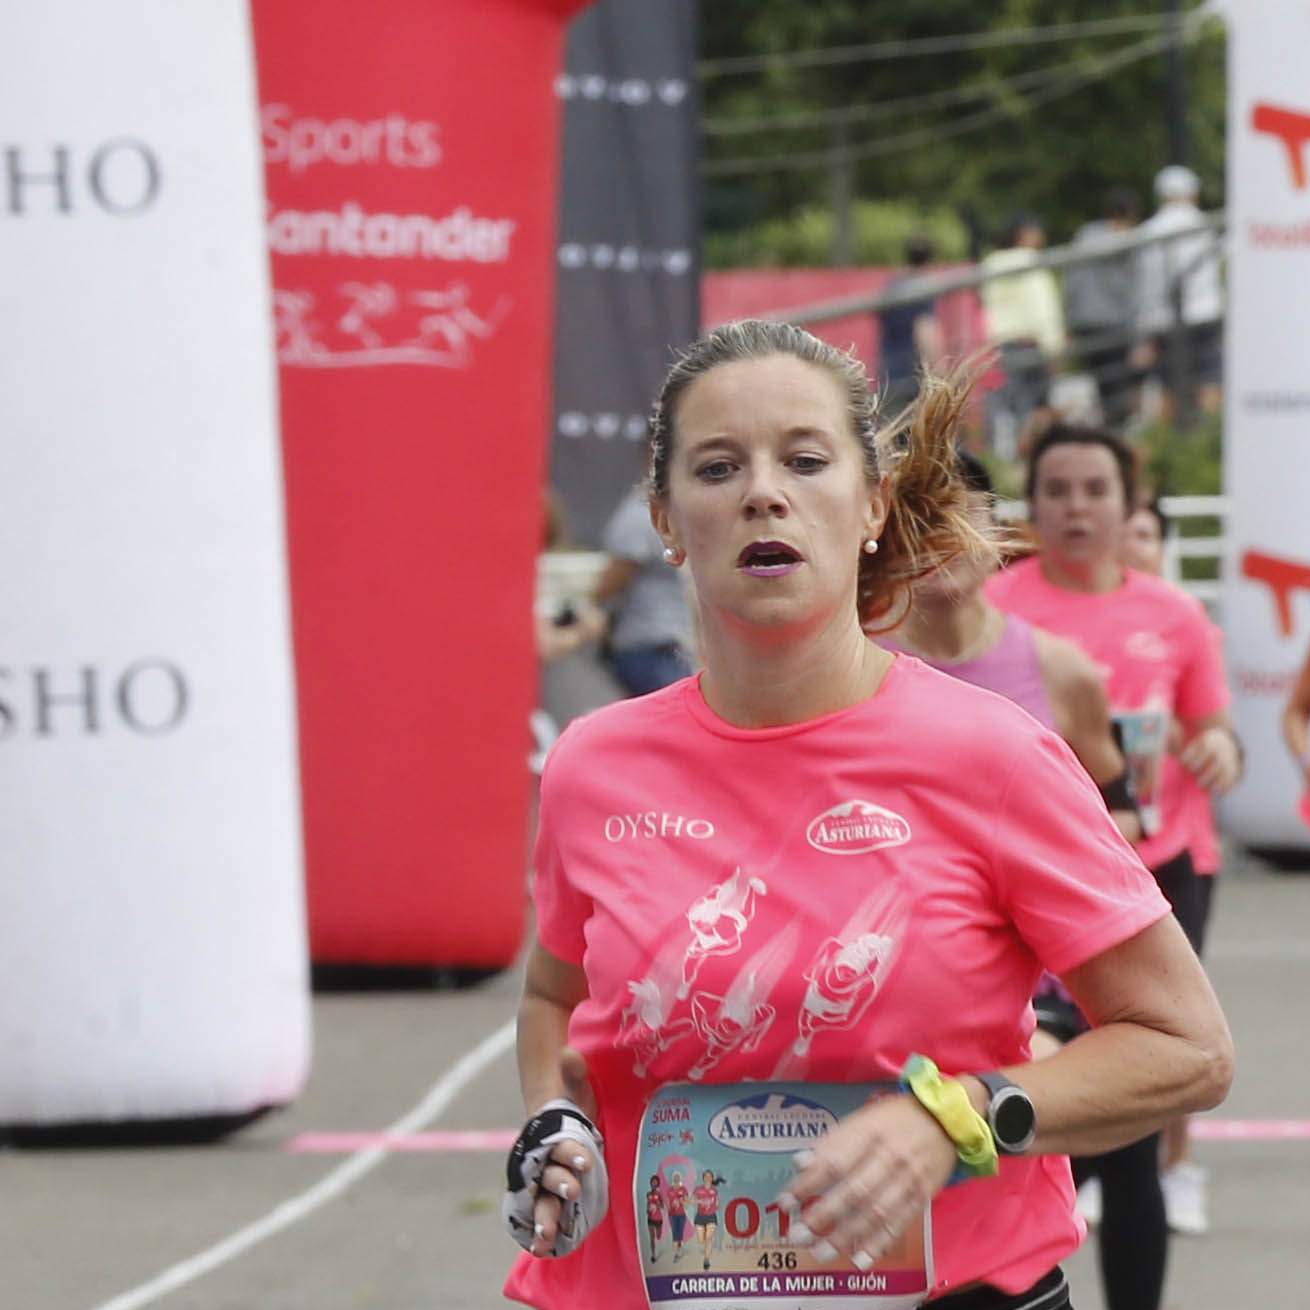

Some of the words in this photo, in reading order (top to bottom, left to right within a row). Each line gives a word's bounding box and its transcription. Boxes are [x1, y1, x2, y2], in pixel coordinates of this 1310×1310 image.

[262, 104, 442, 170] Sports
[266, 202, 516, 263] antander
[604, 811, 715, 842] OYSHO
[814, 822, 903, 843] ASTURIANA
[653, 1107, 690, 1124] SUMA
[757, 1252, 797, 1269] 436
[672, 1279, 735, 1293] CARRERA
[740, 1279, 758, 1292] DE
[763, 1277, 781, 1291] LA
[785, 1276, 834, 1291] MUJER
[847, 1272, 887, 1290] GIJÓN
